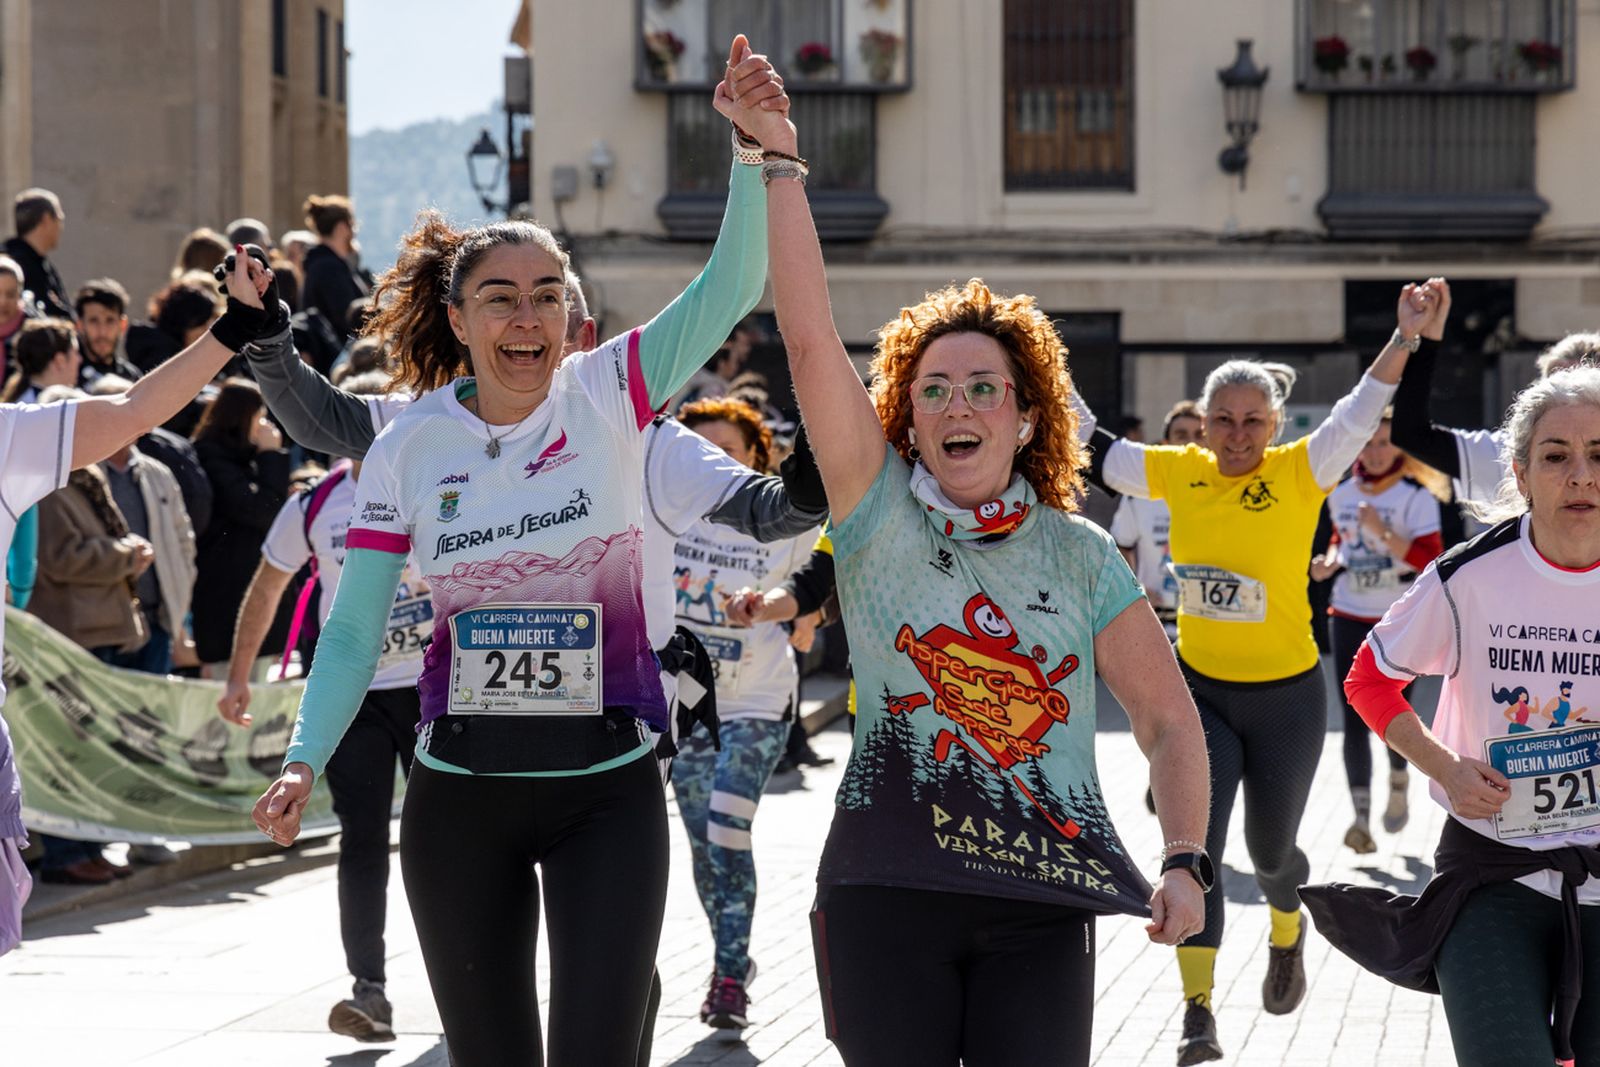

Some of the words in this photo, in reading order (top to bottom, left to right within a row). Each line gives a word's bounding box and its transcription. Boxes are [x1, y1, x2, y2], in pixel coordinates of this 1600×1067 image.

[366, 511, 395, 523] SEGURA
[433, 528, 494, 560] SIERRA
[497, 524, 515, 539] DE
[514, 502, 588, 540] SEGURA
[707, 552, 749, 571] MUERTE
[1200, 581, 1239, 606] 167
[470, 614, 481, 624] VI
[482, 613, 524, 624] CARRERA
[527, 613, 578, 624] CAMINAT
[1026, 604, 1060, 615] SPALL
[471, 629, 505, 645] BUENA
[508, 629, 555, 645] MUERTE
[1489, 624, 1503, 638] VI
[1507, 625, 1577, 642] CARRERA
[484, 650, 562, 690] 245
[1489, 647, 1545, 673] BUENA
[1552, 651, 1600, 676] MUER
[934, 695, 1050, 762] Asperger
[1504, 745, 1515, 754] VI
[1516, 739, 1562, 753] CARRERA
[1506, 757, 1544, 774] BUENA
[1547, 747, 1591, 771] MUERTE
[1534, 769, 1597, 814] 521
[931, 803, 1113, 877] PARAISO
[934, 832, 1025, 867] VIRGEN
[1036, 861, 1119, 896] EXTRA
